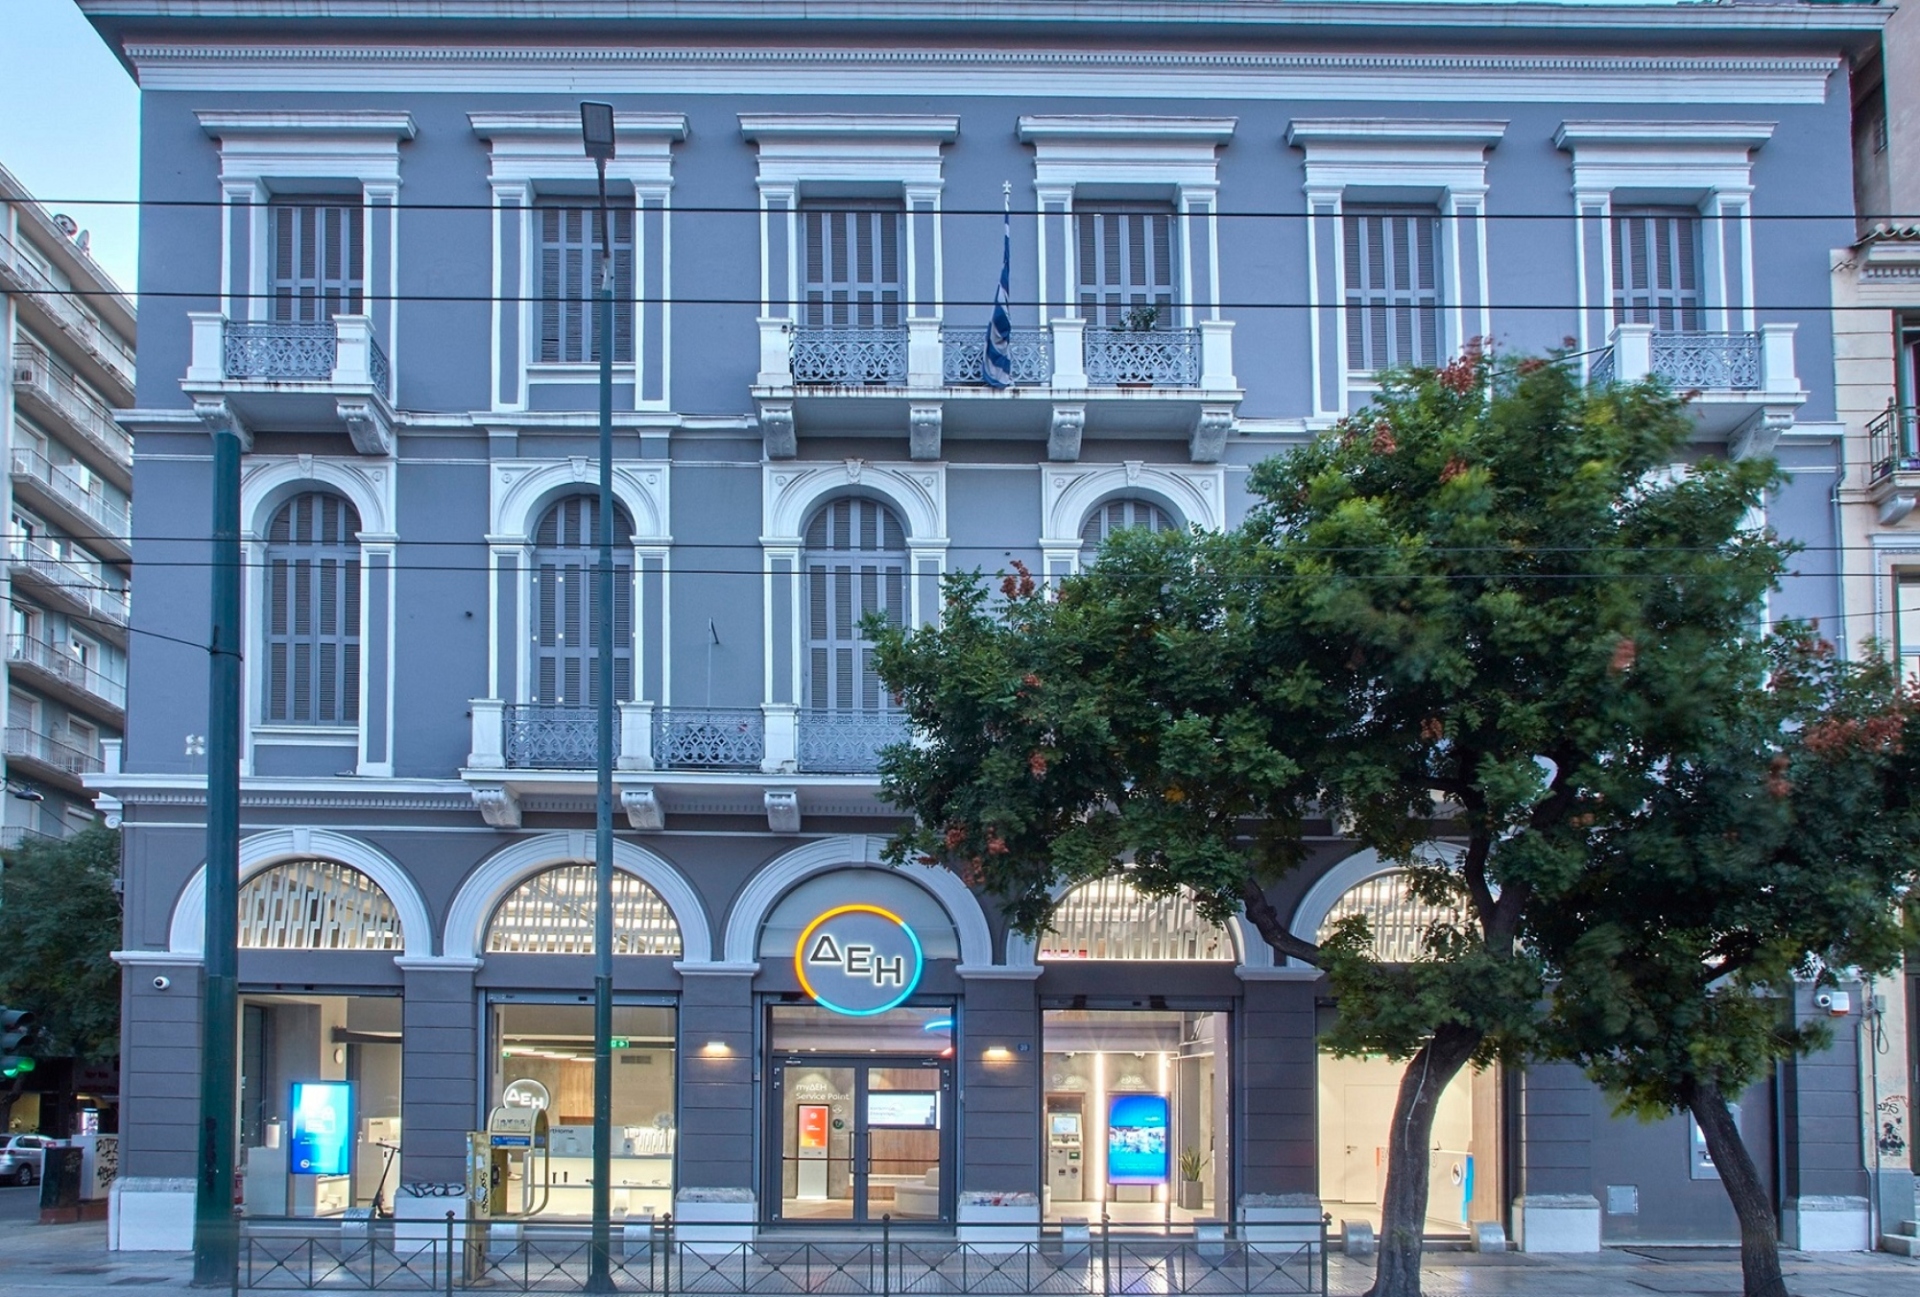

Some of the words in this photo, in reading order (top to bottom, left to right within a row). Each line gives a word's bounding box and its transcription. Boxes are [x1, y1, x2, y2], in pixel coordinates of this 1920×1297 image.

[810, 935, 902, 984] ΔΕΗ
[506, 1088, 544, 1109] ΔΕΗ
[796, 1092, 826, 1100] Service
